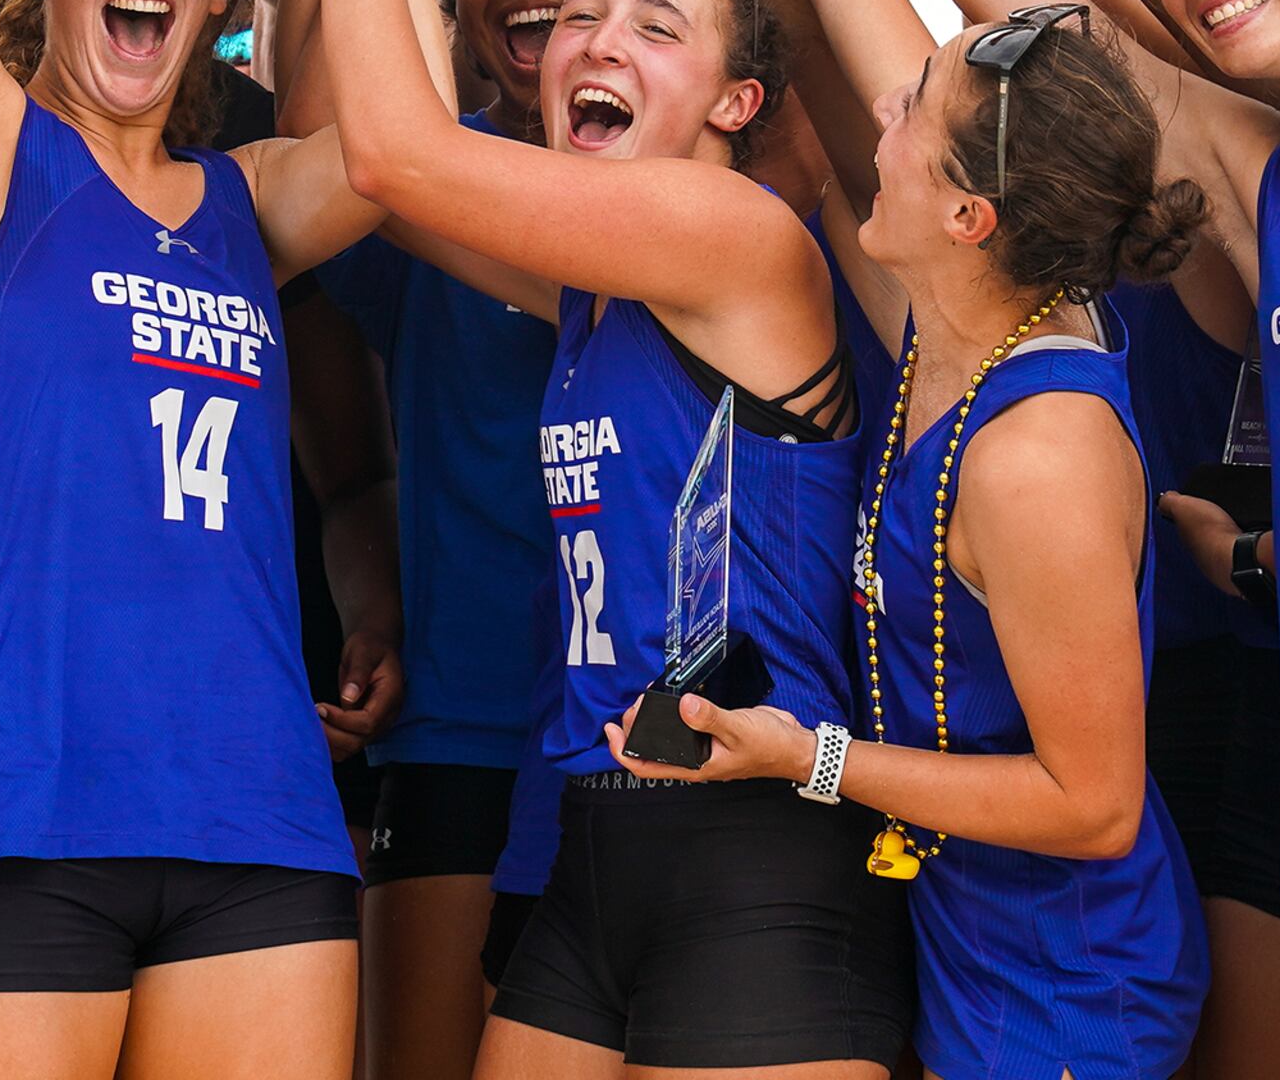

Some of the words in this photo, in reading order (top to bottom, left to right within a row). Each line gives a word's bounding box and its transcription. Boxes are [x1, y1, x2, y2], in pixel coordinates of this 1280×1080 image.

[91, 271, 276, 346] GEORGIA
[131, 312, 262, 377] STATE
[149, 387, 239, 532] 14
[540, 416, 622, 464] ORGIA
[559, 530, 617, 667] 12
